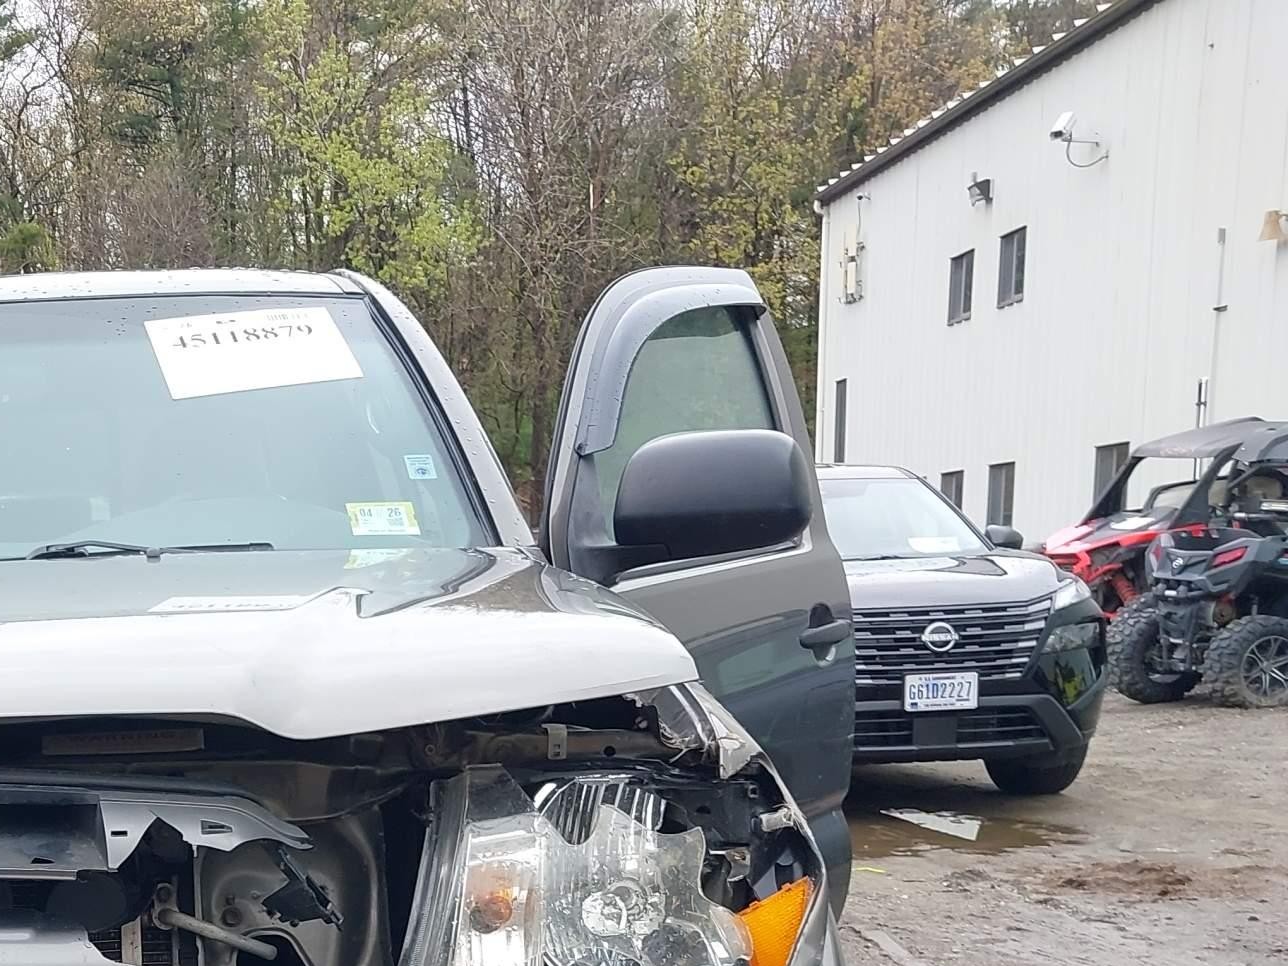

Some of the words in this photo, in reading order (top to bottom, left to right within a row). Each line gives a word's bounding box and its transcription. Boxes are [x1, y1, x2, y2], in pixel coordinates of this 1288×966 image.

[172, 324, 313, 349] 45118879
[359, 507, 373, 518] 04
[387, 507, 402, 518] 26
[909, 681, 972, 700] G61D2227
